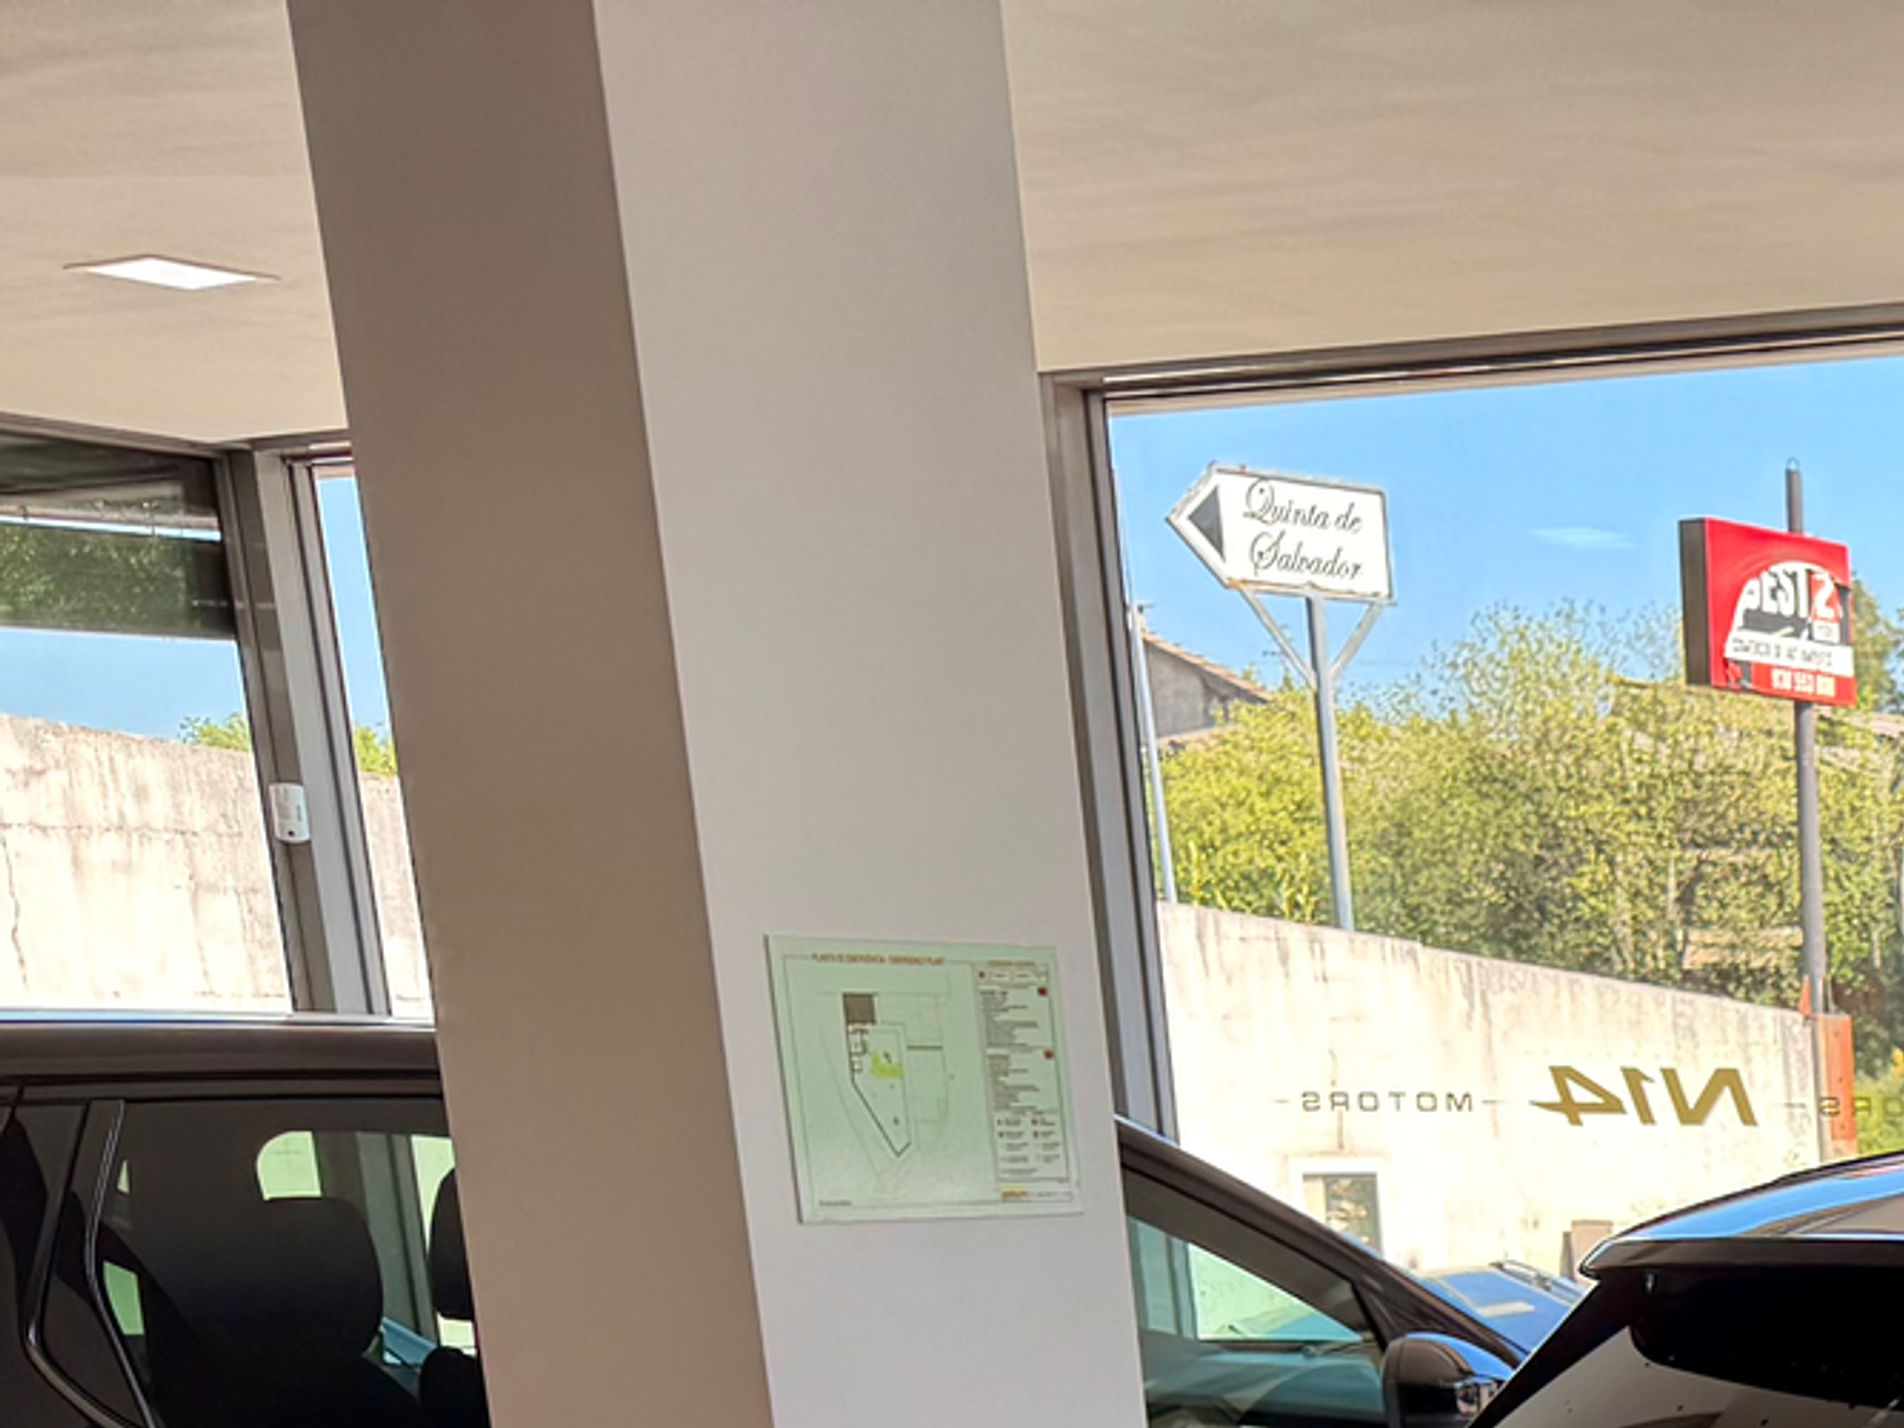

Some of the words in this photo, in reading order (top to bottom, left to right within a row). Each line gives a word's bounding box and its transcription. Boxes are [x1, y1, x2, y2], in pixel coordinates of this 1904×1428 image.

[1243, 477, 1331, 530] Quinta
[1334, 502, 1362, 534] de
[1250, 530, 1363, 579] Salvador
